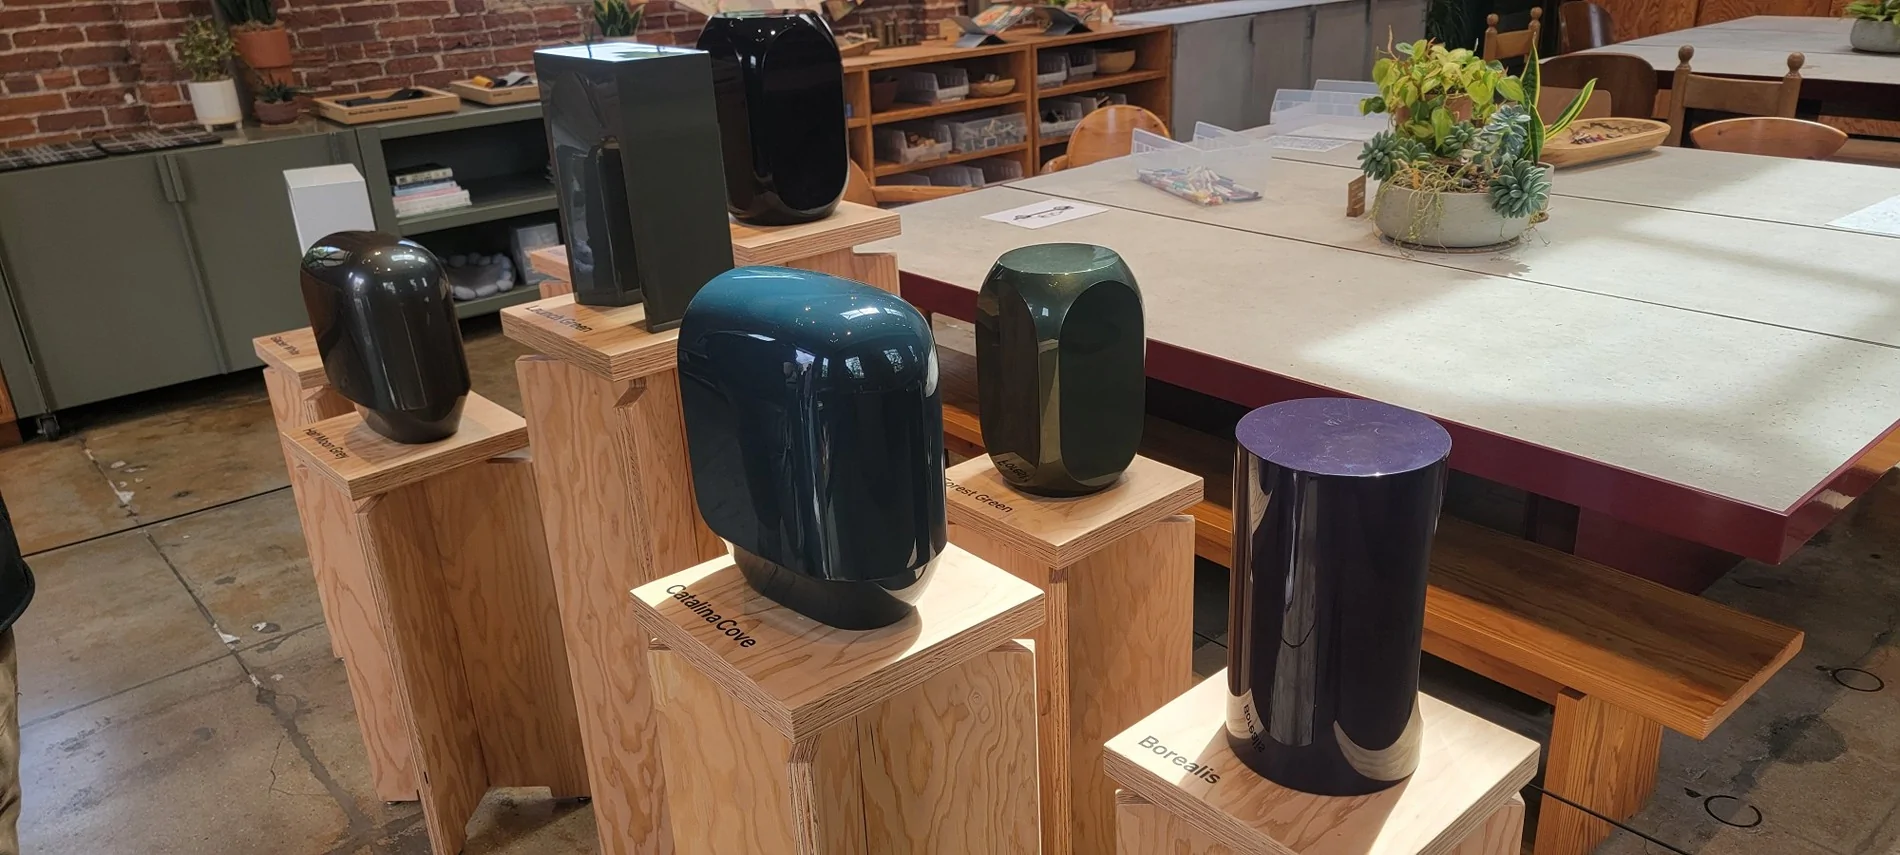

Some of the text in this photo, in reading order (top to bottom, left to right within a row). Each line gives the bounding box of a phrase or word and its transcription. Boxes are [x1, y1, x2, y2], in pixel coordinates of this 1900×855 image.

[560, 318, 593, 332] Green
[975, 494, 1013, 513] Green
[666, 584, 756, 648] Catalina Cove
[1138, 735, 1221, 784] Borealis
